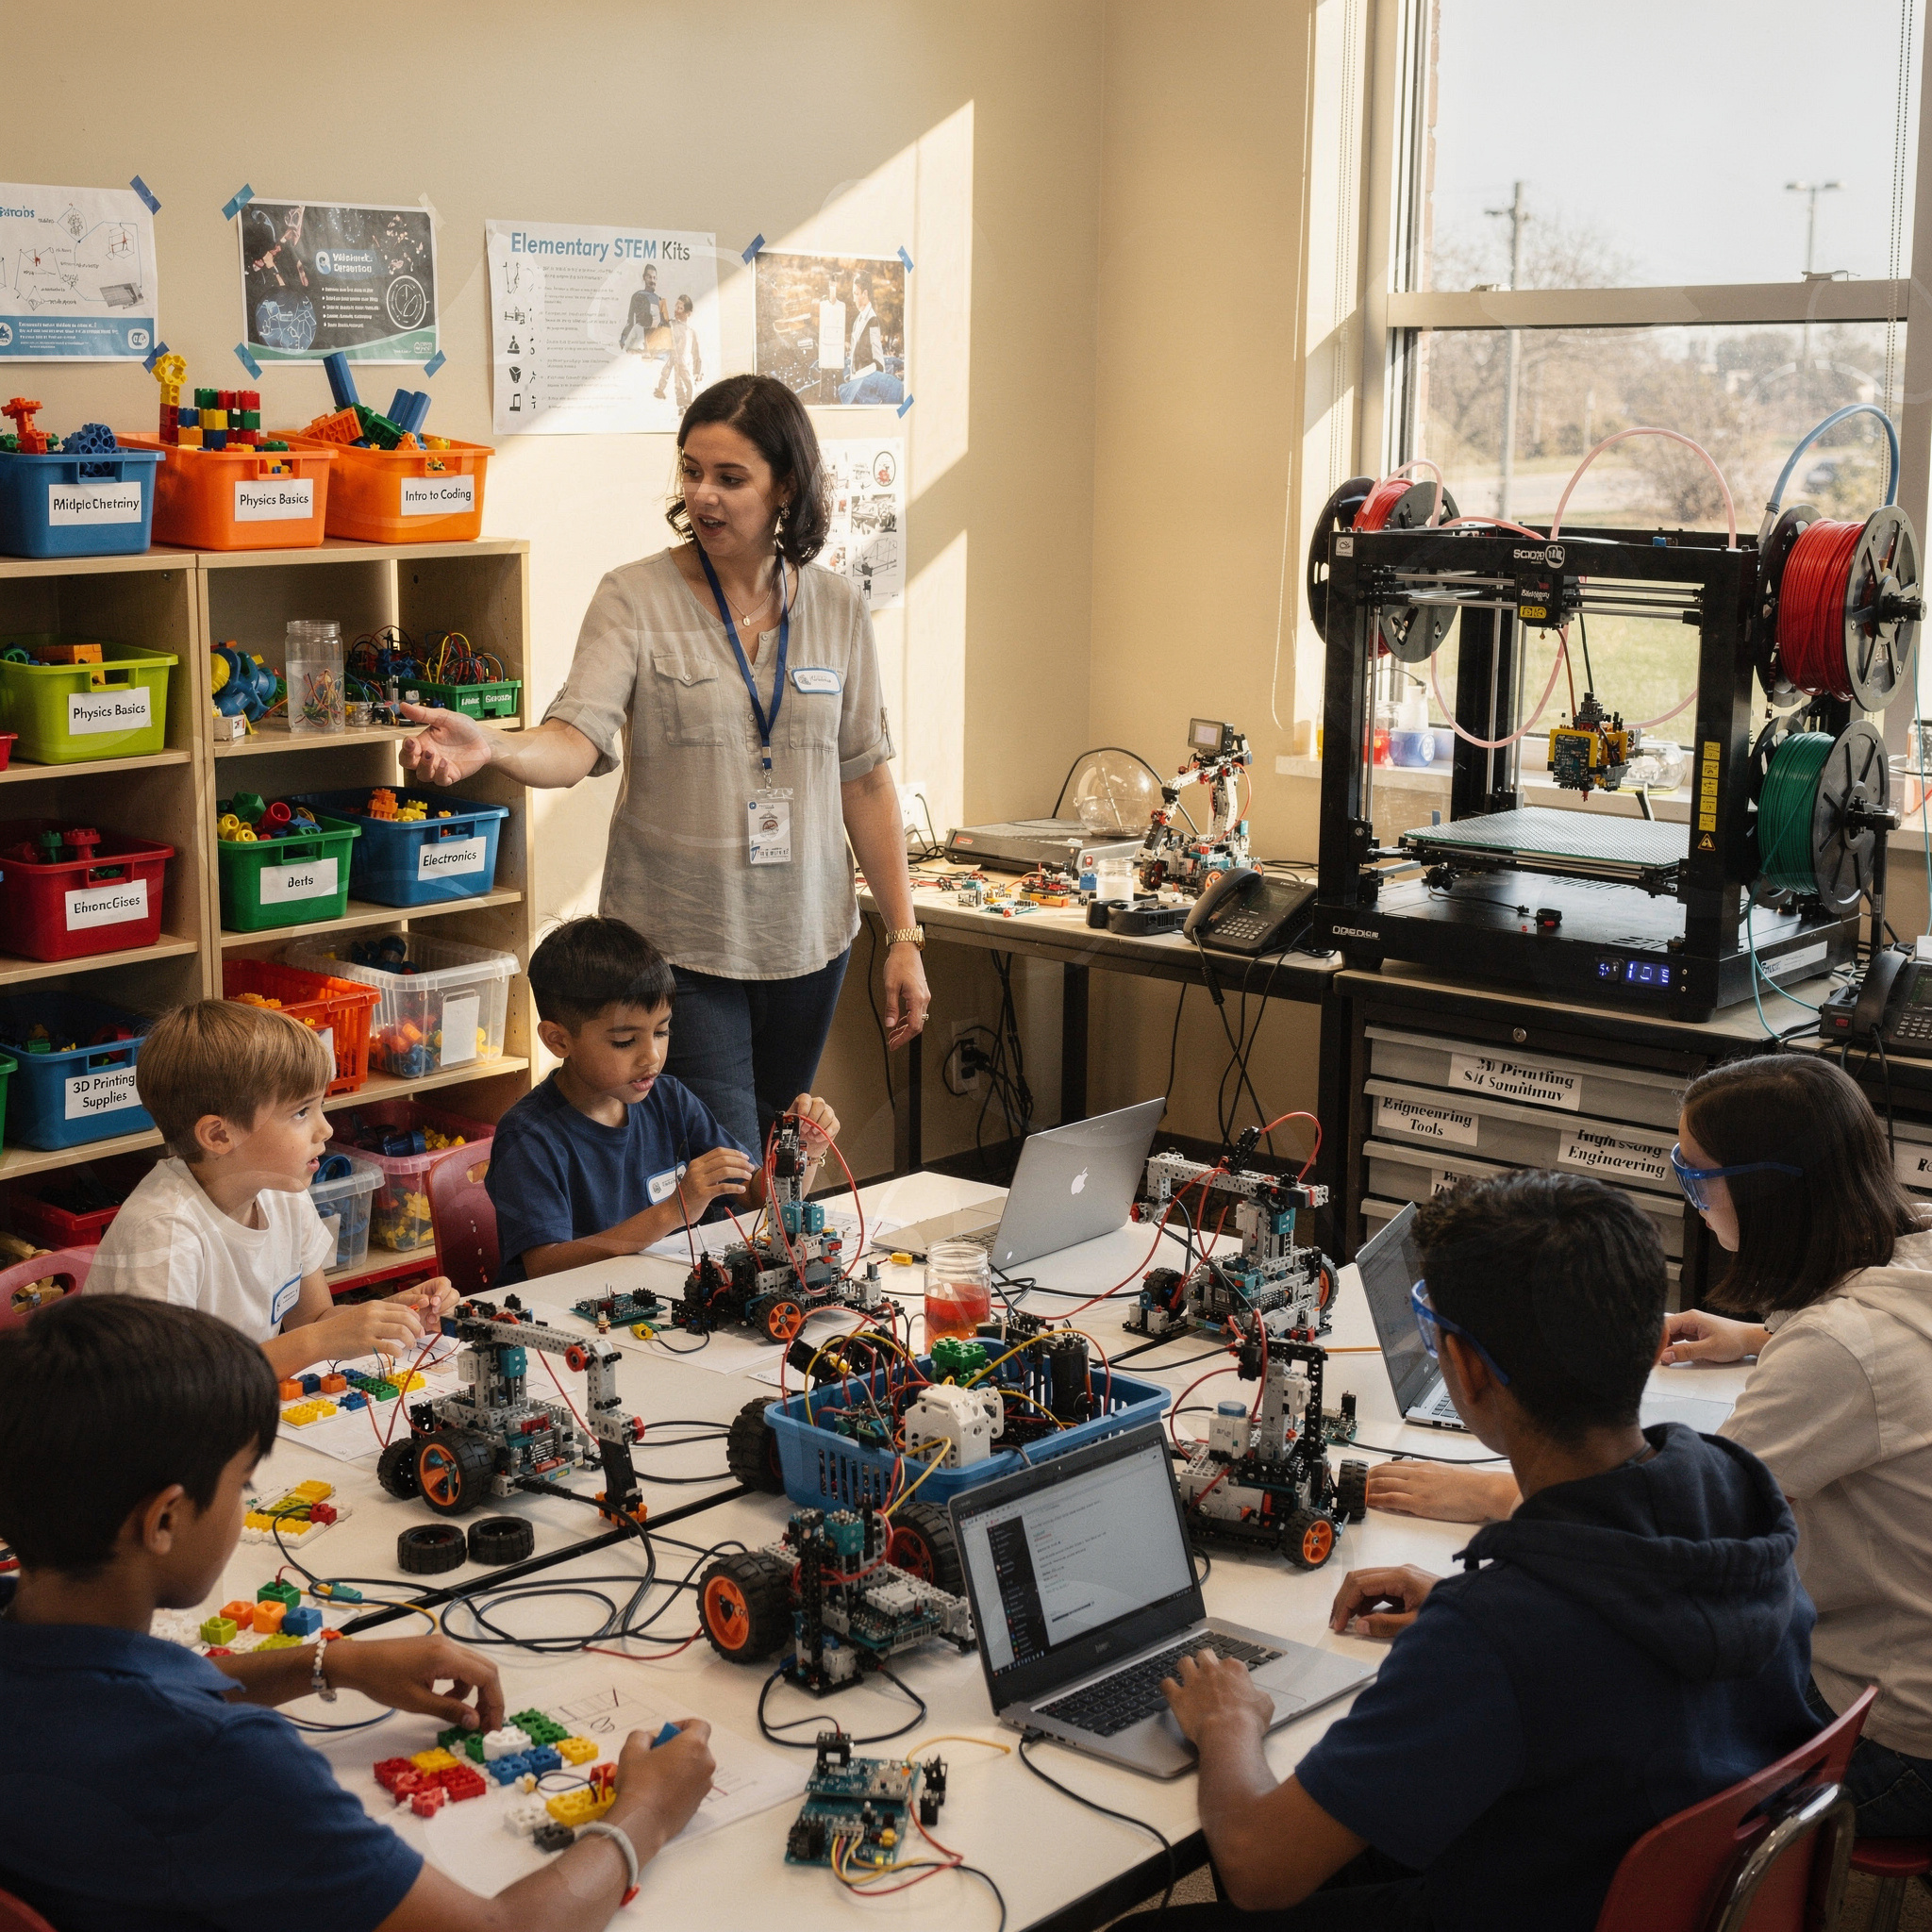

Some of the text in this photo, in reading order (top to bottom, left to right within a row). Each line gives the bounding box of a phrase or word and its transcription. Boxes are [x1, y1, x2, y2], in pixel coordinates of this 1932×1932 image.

[510, 232, 691, 263] Elementary STEM Kits
[240, 492, 309, 507] Physics Basics
[406, 488, 472, 502] Intro to Coding
[73, 703, 146, 722] Physics Basics
[423, 850, 477, 867] Electronics
[73, 1074, 136, 1093] 3D Printing
[82, 1091, 127, 1109] Supplies
[1409, 1118, 1444, 1136] Tools
